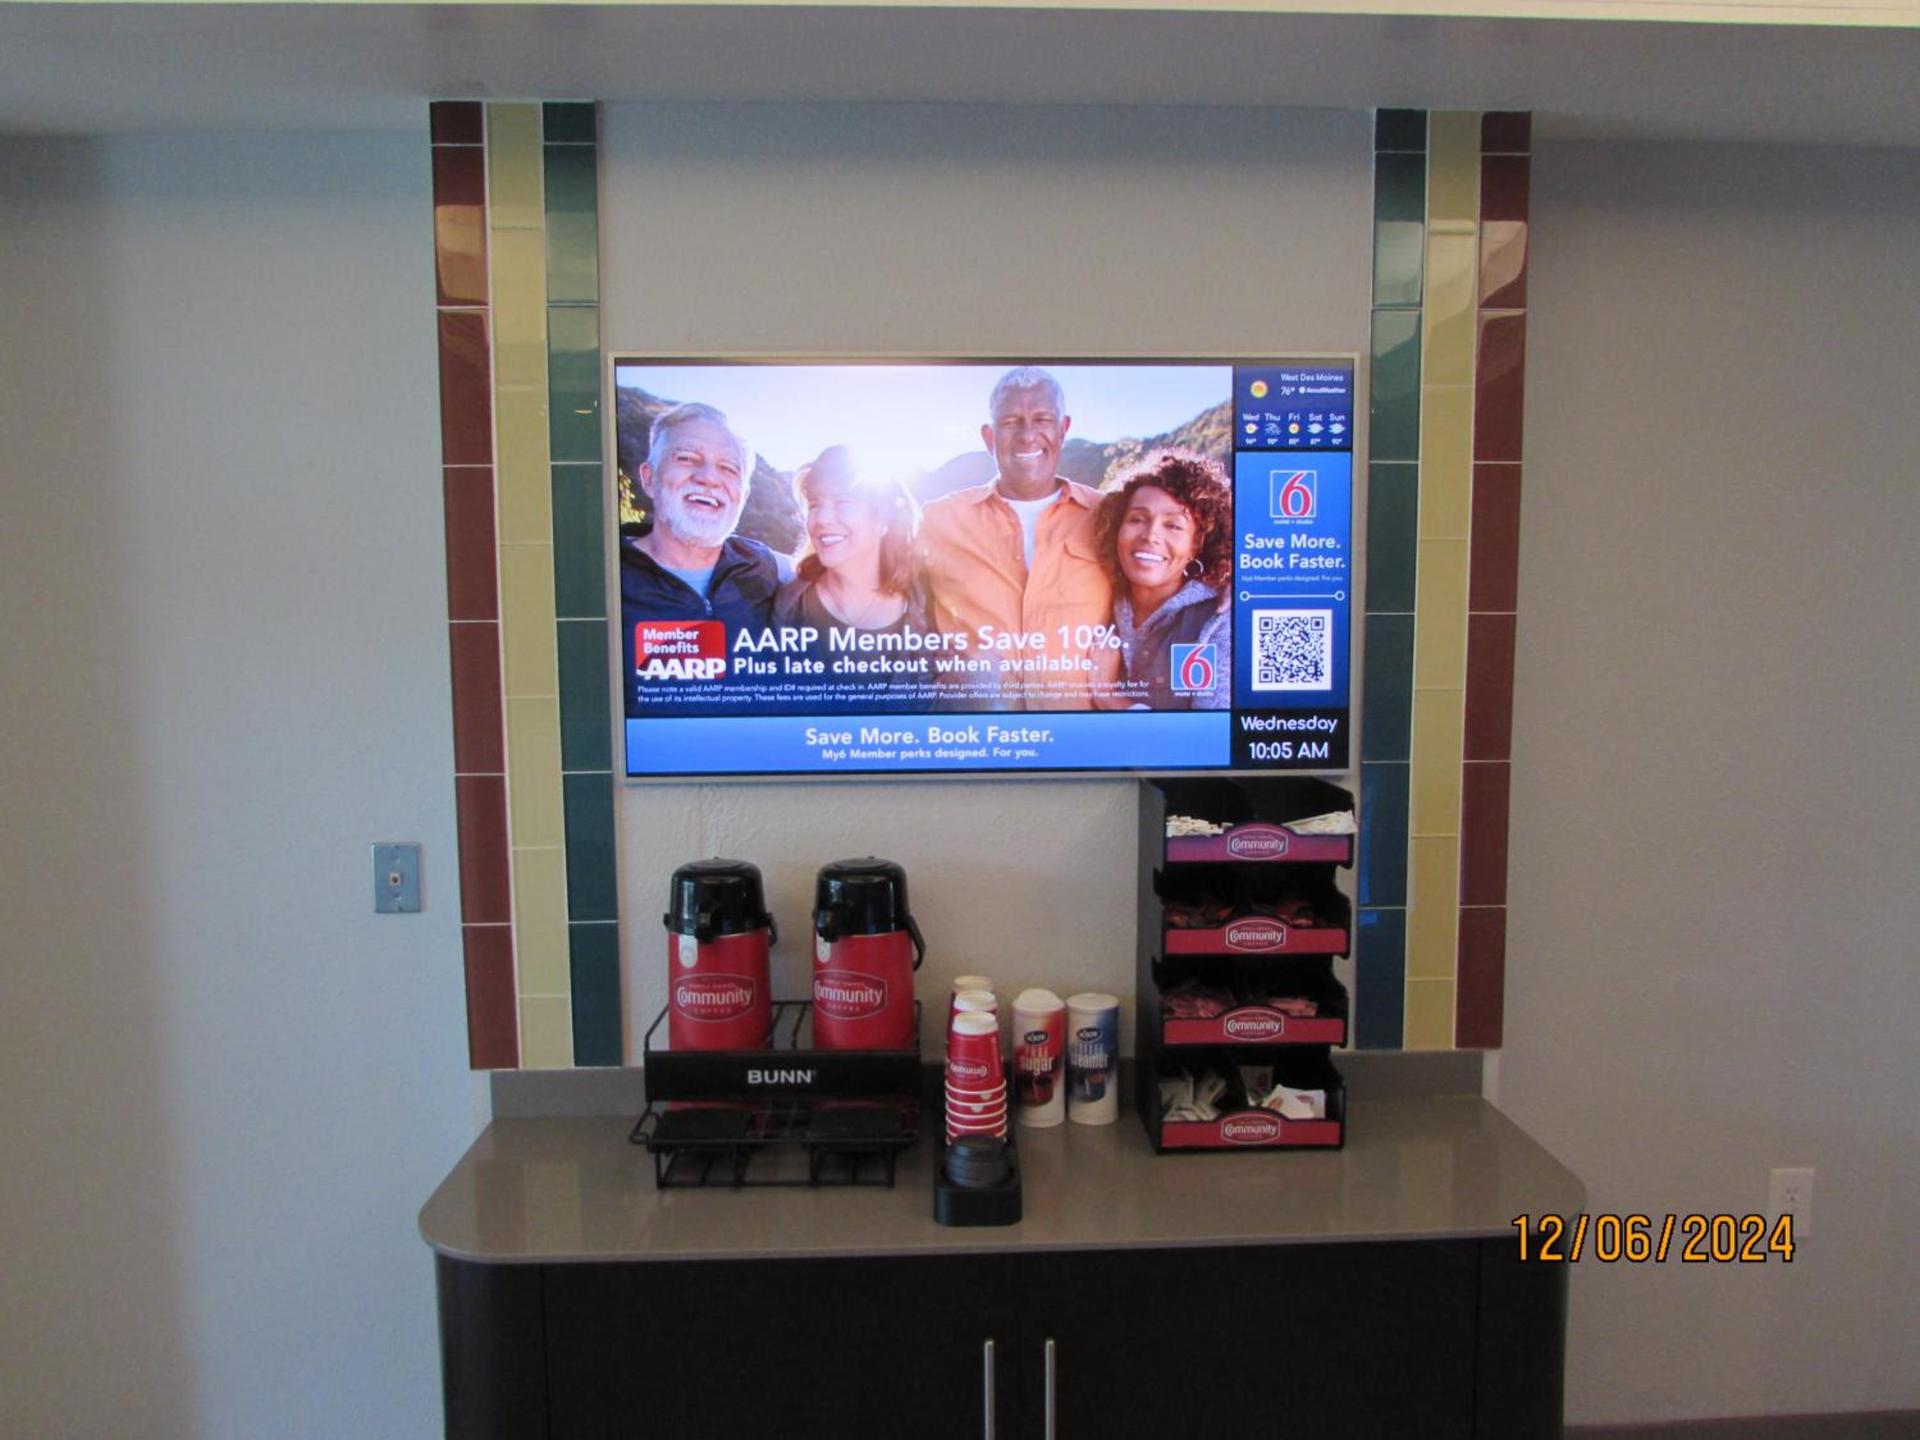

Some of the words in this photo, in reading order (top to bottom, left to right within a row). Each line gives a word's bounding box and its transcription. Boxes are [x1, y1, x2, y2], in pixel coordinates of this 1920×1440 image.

[1300, 373, 1314, 381] Des
[1242, 412, 1260, 421] Wed
[1264, 412, 1281, 421] Thu
[1288, 412, 1300, 421] Fri
[1308, 412, 1322, 421] Sat
[1329, 412, 1345, 421] Sun
[1280, 470, 1313, 518] 6
[1244, 533, 1285, 549] Save
[1290, 533, 1341, 549] More.
[1240, 552, 1284, 569] Book
[1289, 553, 1346, 569] Faster.
[643, 628, 699, 641] Member
[733, 627, 819, 652] AARP
[829, 625, 968, 652] Members
[977, 625, 1046, 651] Save
[1057, 624, 1130, 650] 10%.
[643, 641, 700, 655] Benefits
[640, 657, 726, 681] AARP
[734, 656, 778, 674] Plus
[784, 656, 825, 674] late
[833, 655, 929, 674] checkout
[935, 655, 992, 672] when
[999, 655, 1099, 672] available.
[1181, 644, 1213, 690] 6
[1240, 716, 1338, 734] Wednesday
[805, 727, 853, 746] Save
[860, 727, 920, 745] More.
[928, 725, 980, 744] Book
[987, 725, 1054, 743] Faster.
[822, 749, 847, 761] My6
[850, 748, 896, 759] Member
[900, 748, 931, 760] perks
[935, 747, 989, 760] designed.
[993, 748, 1012, 757] For
[1015, 749, 1039, 760] you.
[1249, 742, 1293, 759] 10:05
[1297, 742, 1329, 759] AM
[1231, 838, 1285, 852] Community
[1230, 929, 1282, 943] Community
[677, 985, 753, 1008] Community
[1227, 1019, 1281, 1033] Community
[747, 1069, 813, 1084] BUNN
[1225, 1123, 1278, 1137] Community
